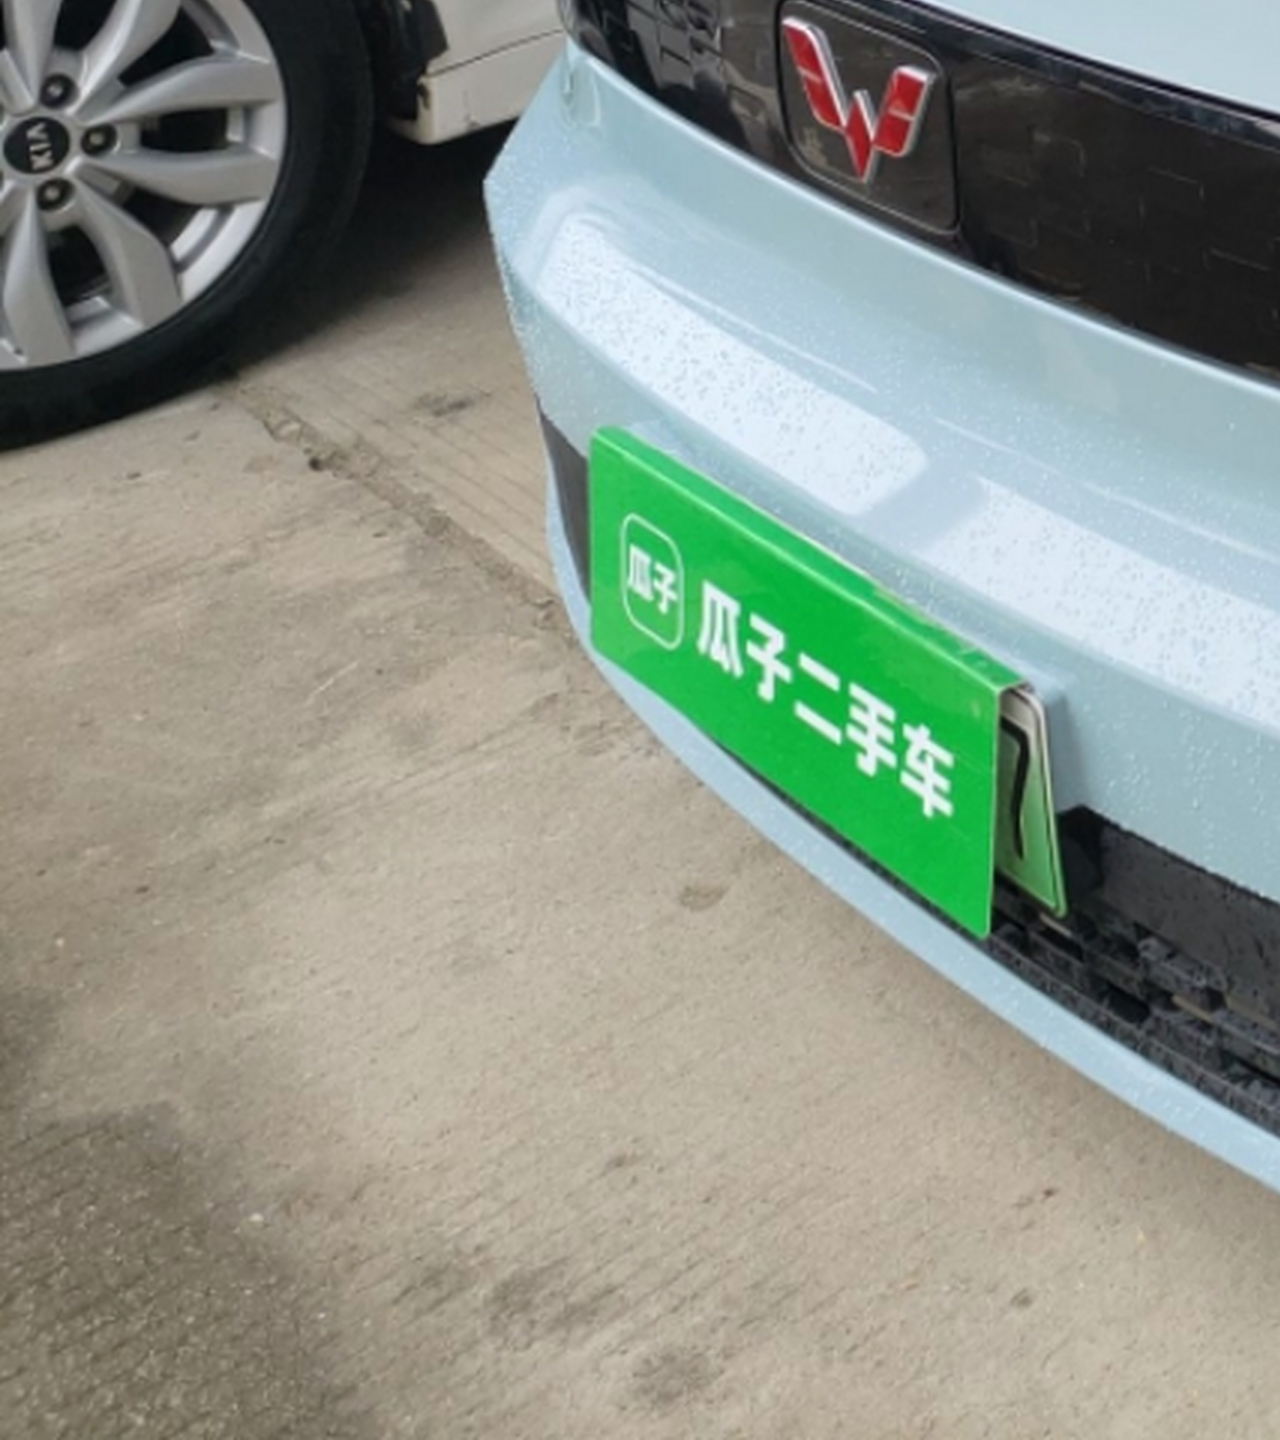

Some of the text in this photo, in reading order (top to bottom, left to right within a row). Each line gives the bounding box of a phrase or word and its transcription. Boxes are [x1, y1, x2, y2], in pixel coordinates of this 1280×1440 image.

[626, 543, 679, 616] 瓜子
[697, 579, 955, 819] 瓜子二手车
